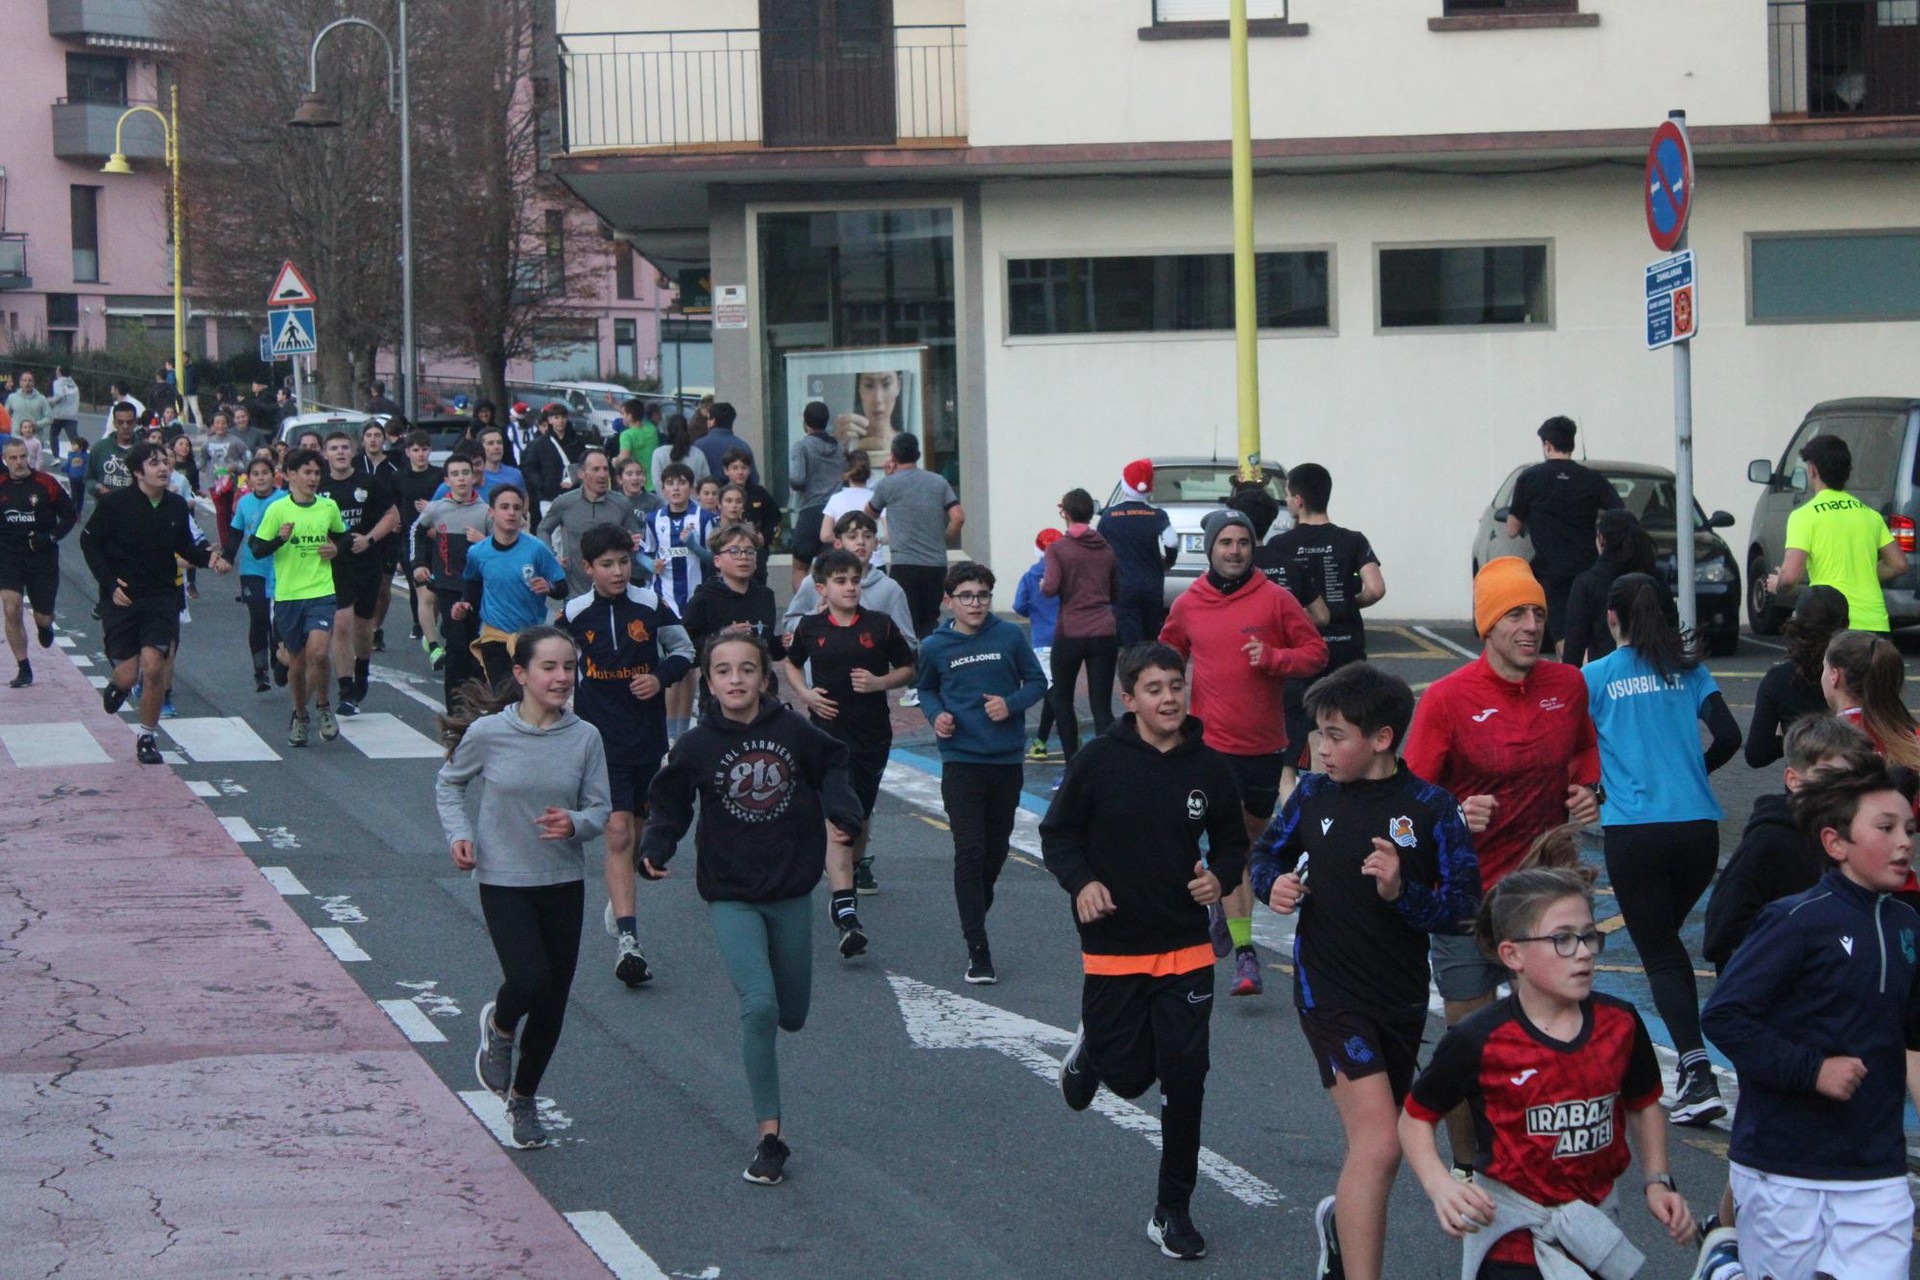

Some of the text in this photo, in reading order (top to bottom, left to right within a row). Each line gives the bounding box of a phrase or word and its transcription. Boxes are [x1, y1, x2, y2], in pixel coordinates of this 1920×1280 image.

[950, 652, 1002, 669] JACK&JONES
[1606, 674, 1661, 700] USURBIL
[720, 749, 740, 767] TOL
[1556, 1118, 1611, 1154] ARTE!
